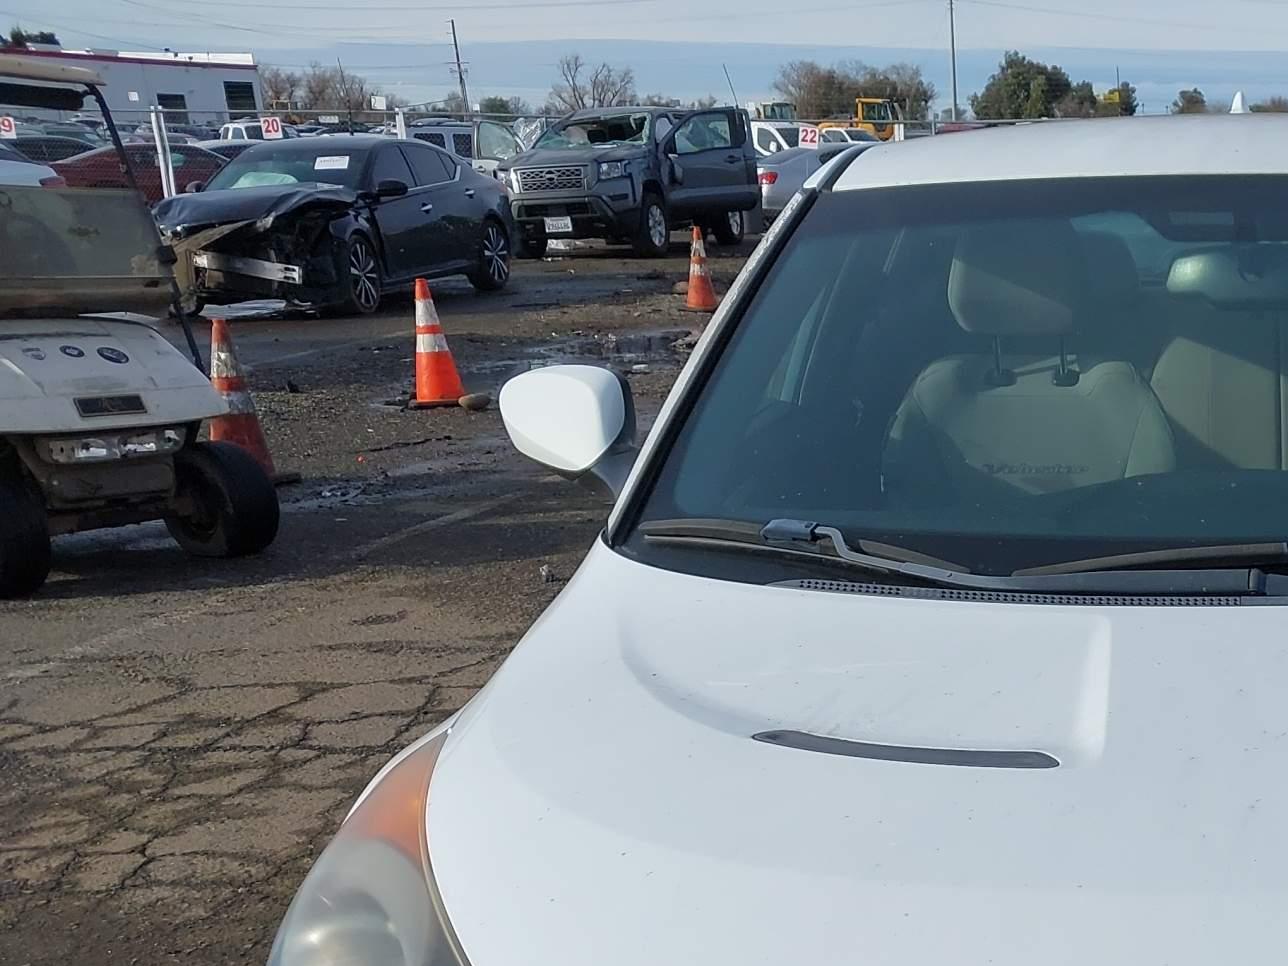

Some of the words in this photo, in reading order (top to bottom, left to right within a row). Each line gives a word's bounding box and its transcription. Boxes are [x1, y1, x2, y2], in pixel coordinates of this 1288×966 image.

[1, 118, 12, 132] 9
[263, 118, 279, 133] 20
[801, 128, 817, 143] 22
